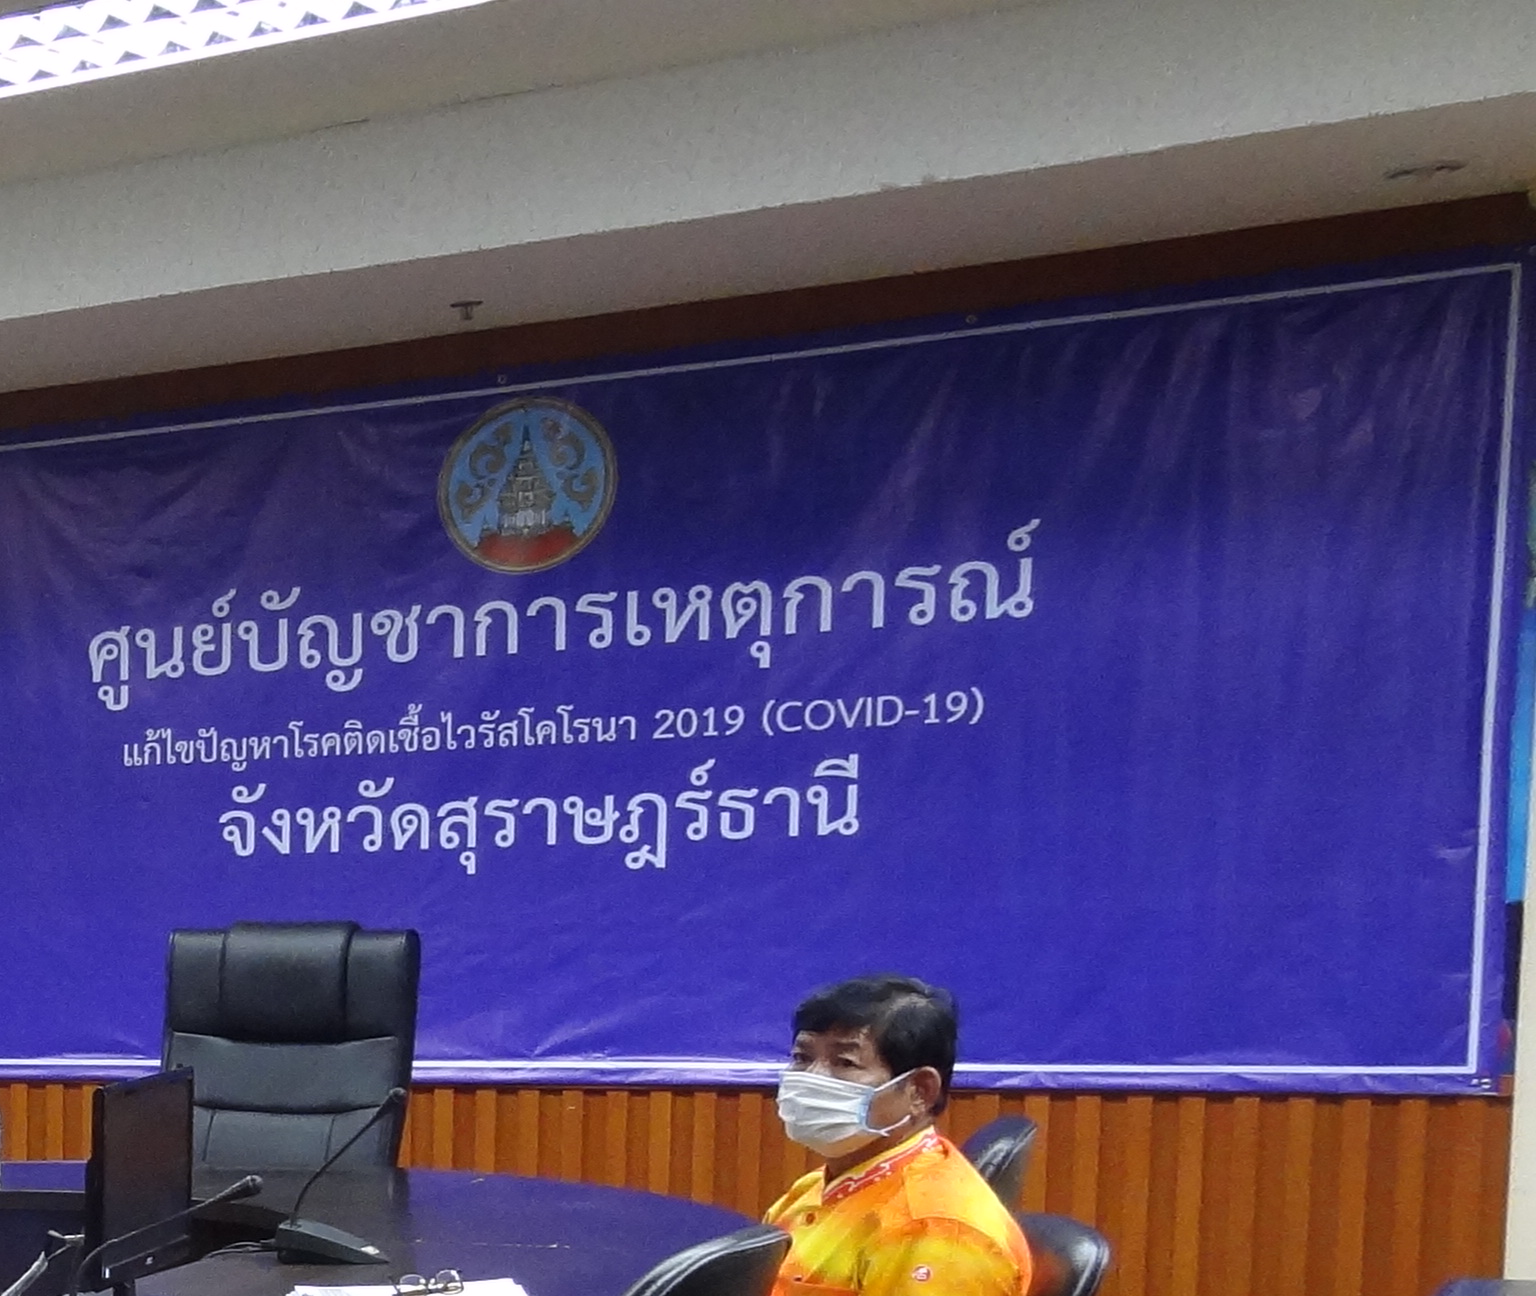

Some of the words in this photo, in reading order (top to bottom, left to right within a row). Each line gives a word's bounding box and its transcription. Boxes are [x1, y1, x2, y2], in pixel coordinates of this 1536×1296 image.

[88, 518, 1041, 712] ศูนย์บัญชาการเหตุการณ์
[123, 703, 637, 772] แก้ไขปัญหาโรคติดเชื้อไวรัสโคโรนา
[652, 705, 745, 739] 2019
[761, 686, 985, 736] (COVID-19)
[218, 753, 860, 875] จังหวัดสุราษฎร์ธานี
